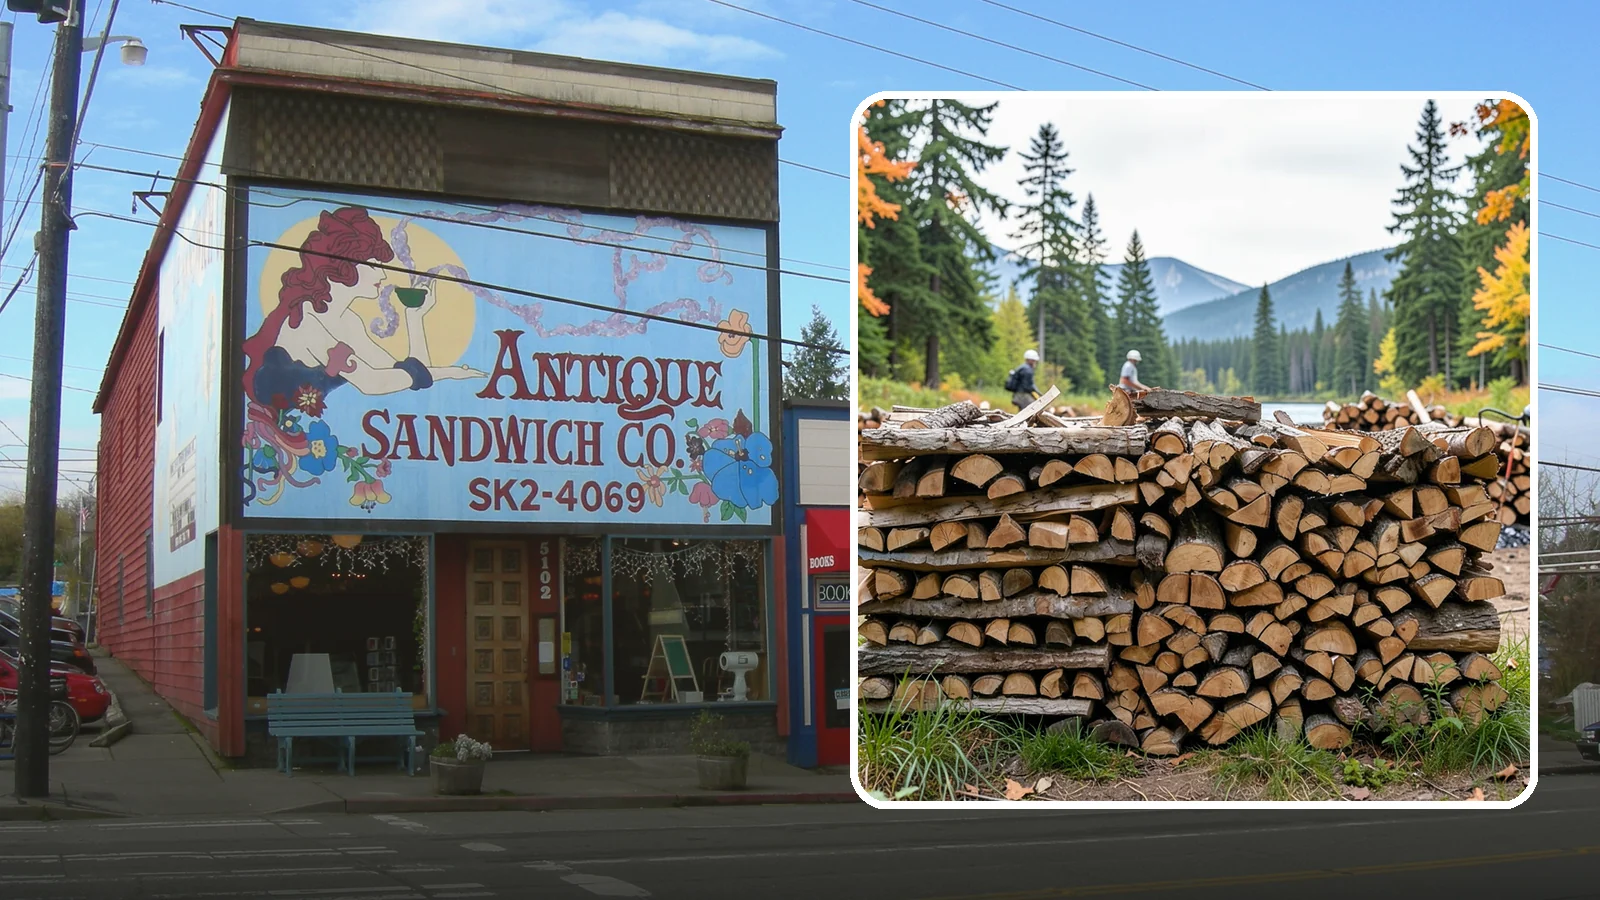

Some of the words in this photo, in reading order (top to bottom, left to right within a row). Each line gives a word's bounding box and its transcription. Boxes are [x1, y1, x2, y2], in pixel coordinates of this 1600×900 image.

[476, 329, 724, 420] ANTIQUE
[361, 408, 605, 468] SANDWICH
[617, 421, 685, 469] CO.
[468, 477, 646, 514] SK2-4069
[539, 541, 552, 600] 5102
[809, 555, 835, 569] BOOKS
